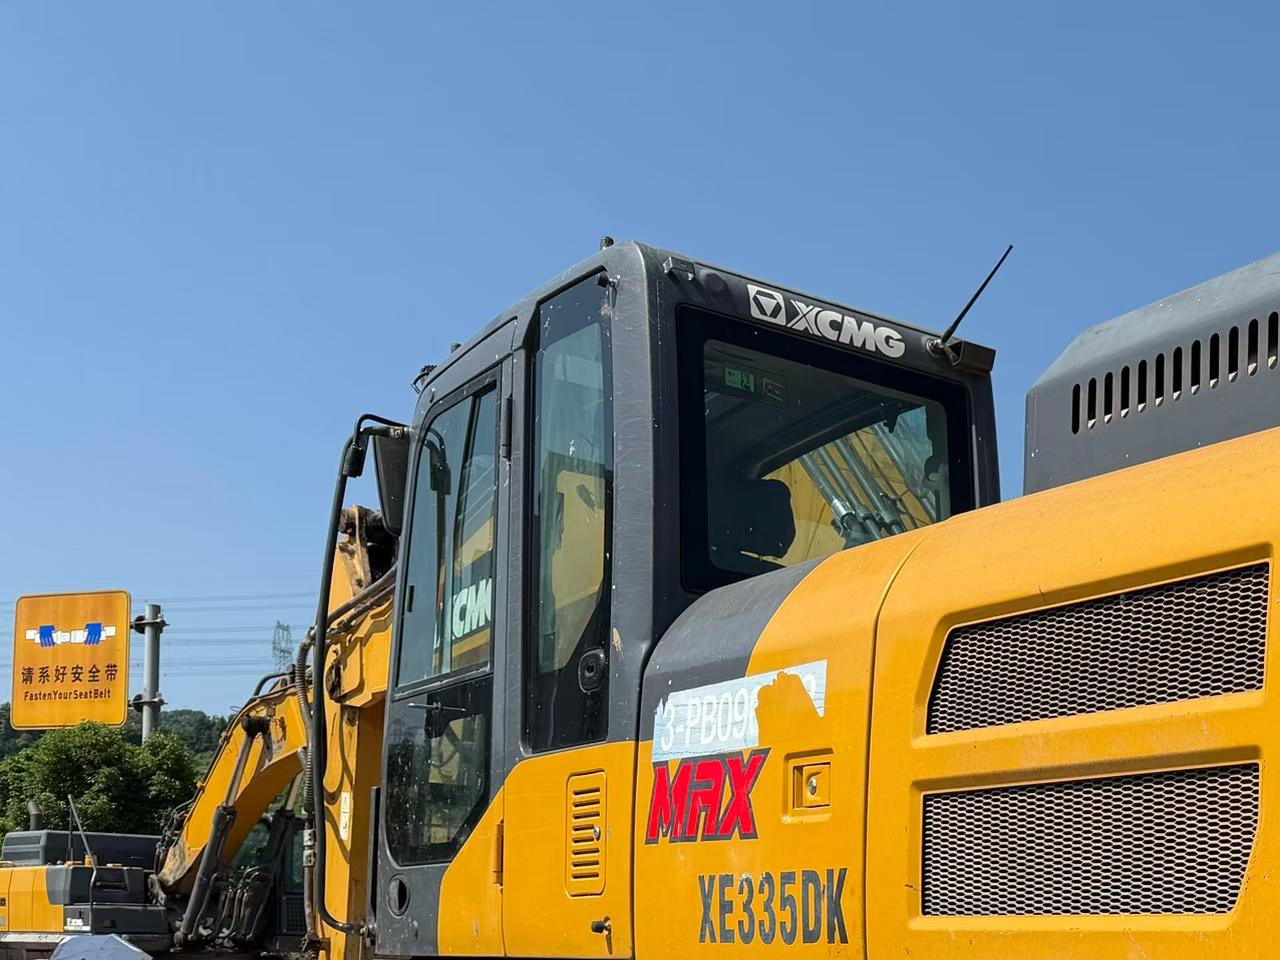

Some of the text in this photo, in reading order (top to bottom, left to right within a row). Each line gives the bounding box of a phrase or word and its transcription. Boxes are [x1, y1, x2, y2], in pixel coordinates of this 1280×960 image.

[786, 299, 906, 359] XCMG
[453, 577, 491, 648] CM
[21, 663, 118, 684] 请系好安全带
[645, 748, 770, 844] MAX
[698, 868, 849, 945] XE335DK
